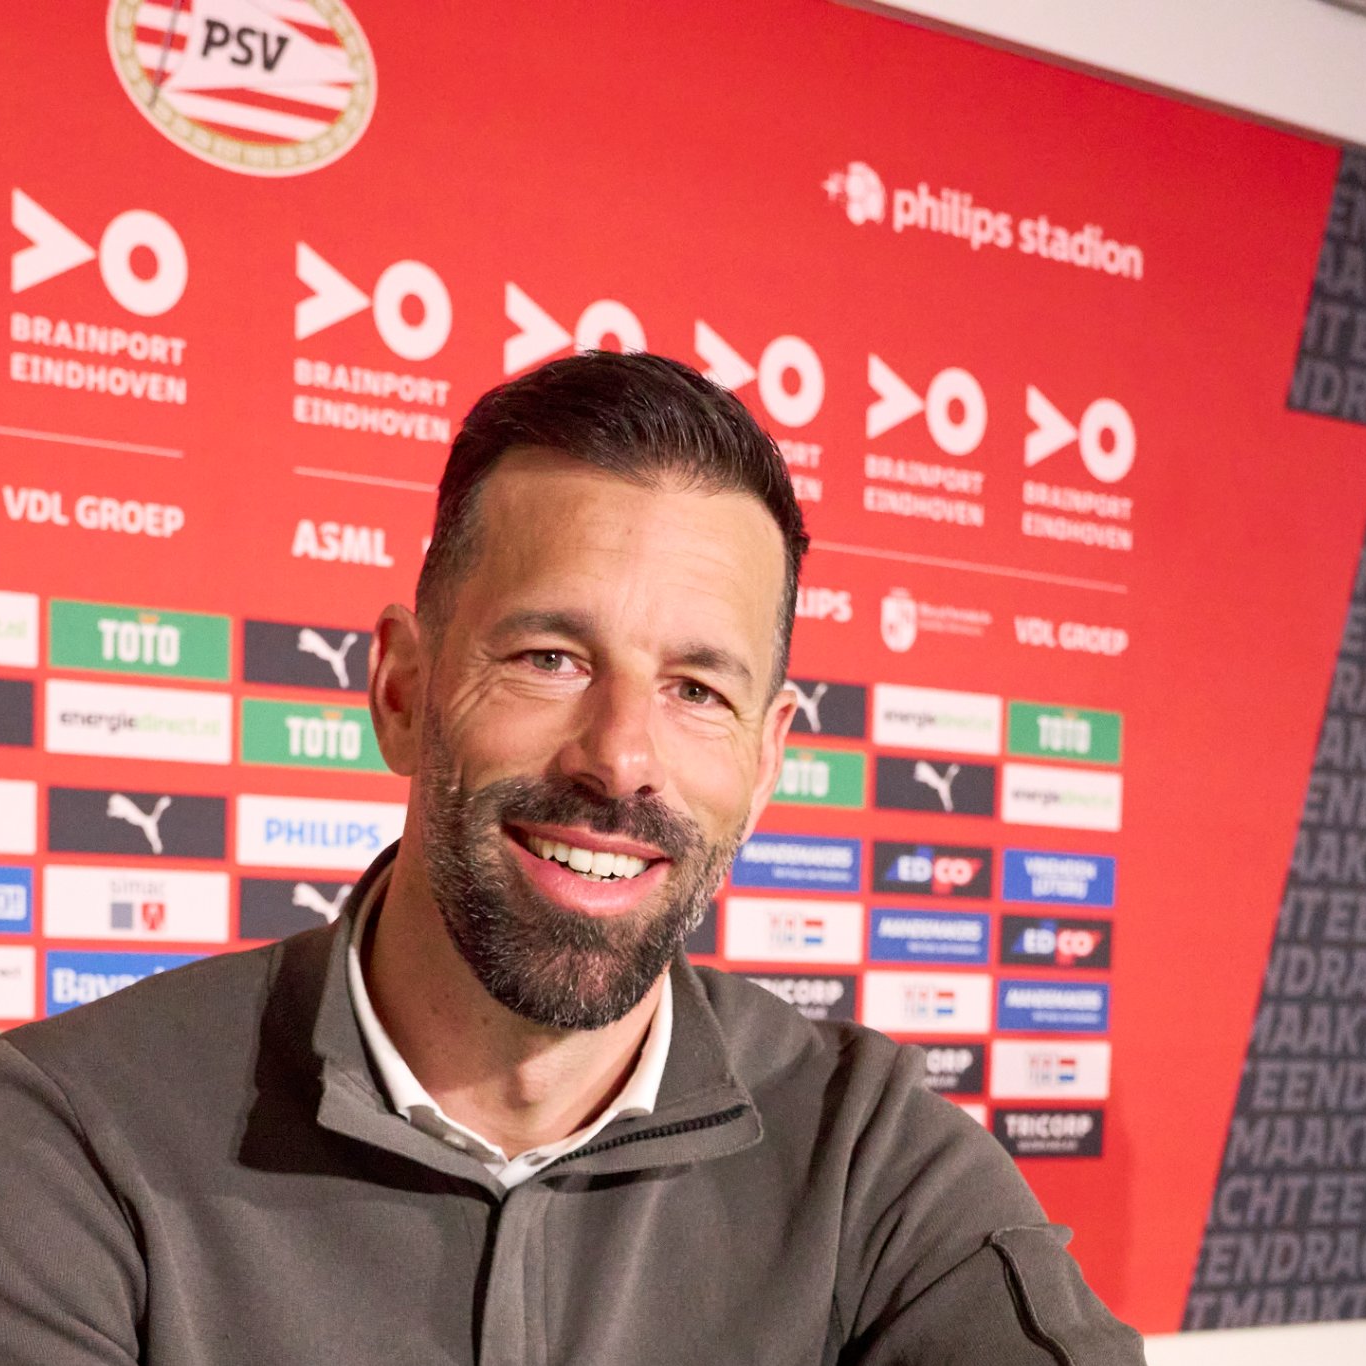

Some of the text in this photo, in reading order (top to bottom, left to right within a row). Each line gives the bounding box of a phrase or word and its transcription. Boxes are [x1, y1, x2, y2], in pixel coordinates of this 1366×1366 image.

[201, 19, 289, 73] PSV
[893, 182, 1143, 280] philips stadion
[10, 312, 188, 366] BRAINPORT
[10, 351, 188, 405] EINDHOVEN
[294, 358, 450, 406] BRAINPORT
[294, 395, 451, 443] EINDHOVEN
[864, 453, 984, 495] BRAINPORT
[1, 485, 69, 528] VDL
[76, 492, 186, 538] GROEP
[863, 486, 984, 527] EINDHOVEN
[1022, 481, 1132, 520] BRAINPORT
[291, 519, 394, 567] ASML
[1022, 510, 1133, 550] EINDHOVEN
[795, 590, 853, 622] LIPS
[99, 617, 180, 666] TOTO
[1014, 616, 1056, 648] VDL
[1058, 622, 1129, 656] GROEP
[285, 714, 363, 759] TOTO
[776, 758, 829, 797] OTO
[264, 817, 383, 850] PHILIPS
